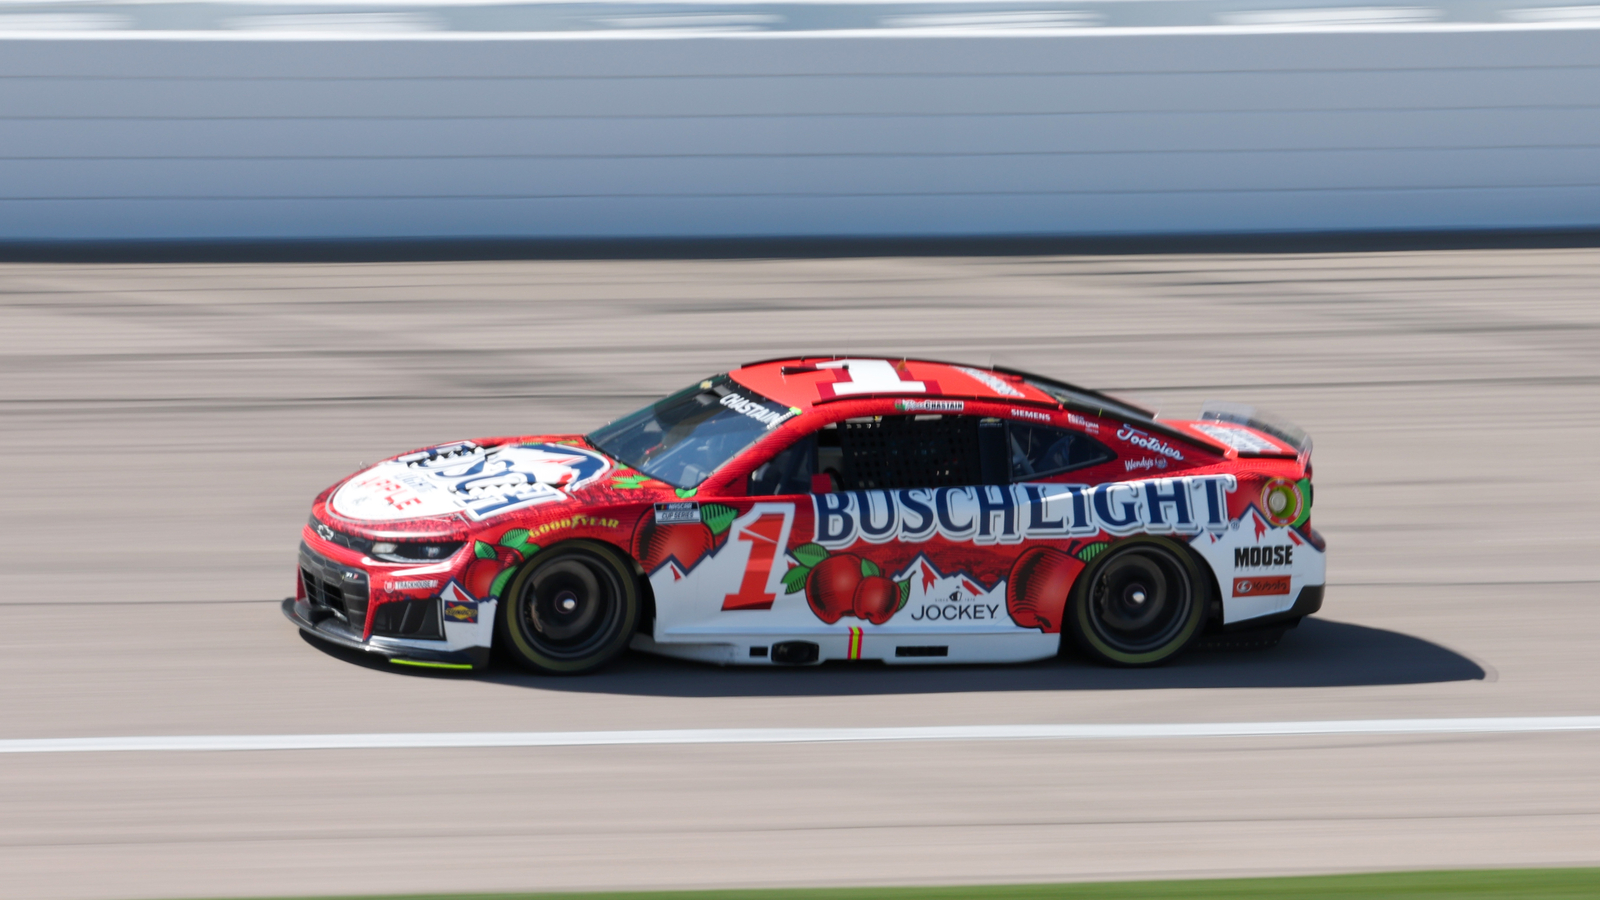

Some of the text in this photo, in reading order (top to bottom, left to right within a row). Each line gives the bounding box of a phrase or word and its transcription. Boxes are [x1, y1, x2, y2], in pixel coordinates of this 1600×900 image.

[815, 359, 926, 396] 1
[719, 393, 781, 424] CHASTAIN
[925, 400, 964, 411] CHASTAIN
[1011, 409, 1051, 421] SIEMENS
[1116, 423, 1185, 461] Tootsies
[812, 484, 1021, 549] BUSCH
[1018, 474, 1236, 538] LIGHT
[528, 515, 620, 538] GOODYEAR
[721, 503, 795, 611] 1
[1234, 545, 1293, 568] MOOSE
[911, 604, 999, 621] JOCKEY
